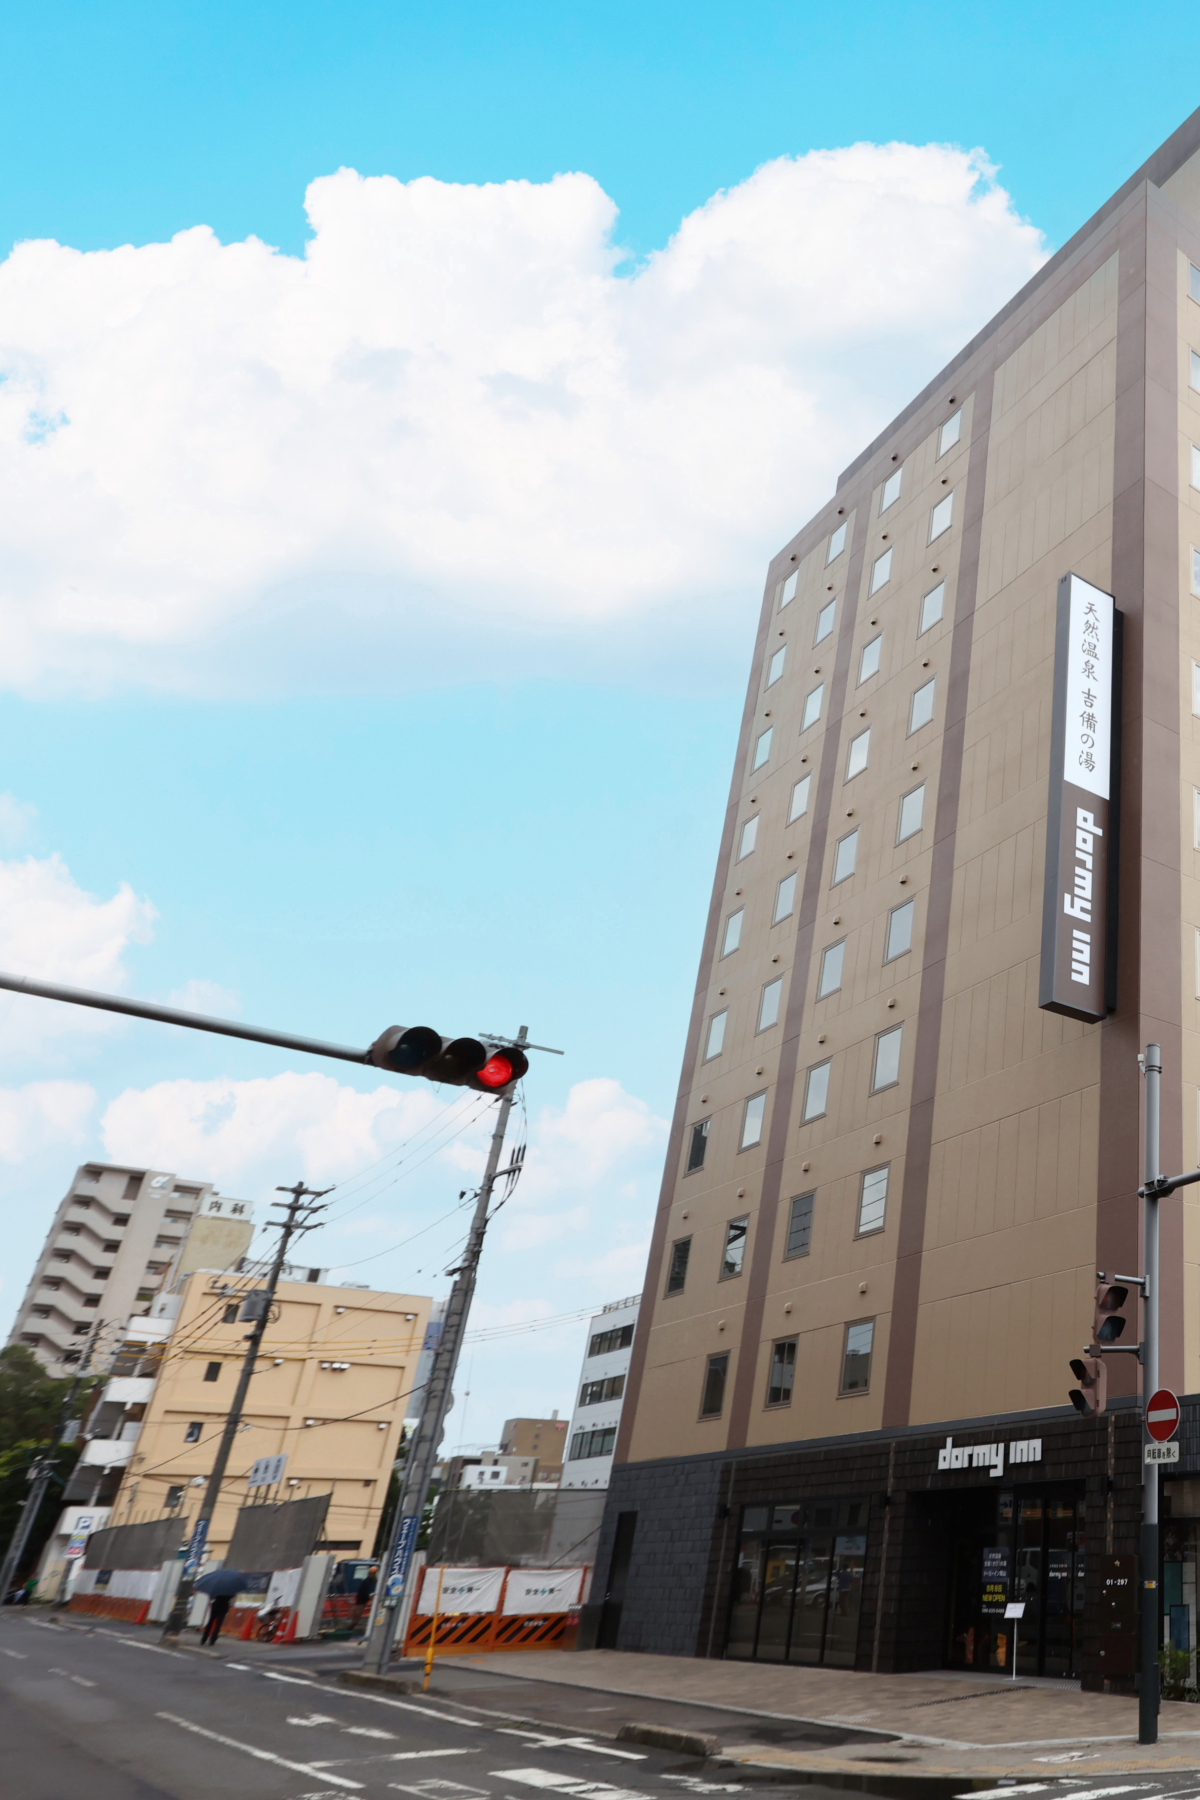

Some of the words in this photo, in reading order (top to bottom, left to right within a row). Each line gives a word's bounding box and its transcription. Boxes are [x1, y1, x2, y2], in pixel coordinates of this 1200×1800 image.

[1081, 602, 1100, 682] 天然温泉
[1078, 688, 1098, 773] 吉備の湯
[1063, 806, 1103, 923] dormy
[1071, 928, 1091, 986] inn
[938, 1436, 1005, 1478] dormy
[1009, 1438, 1042, 1464] inn
[1147, 1447, 1176, 1459] 自転車を除く
[982, 1594, 993, 1602] NEW
[993, 1594, 1006, 1602] OPEN
[1106, 1578, 1128, 1586] 01-297
